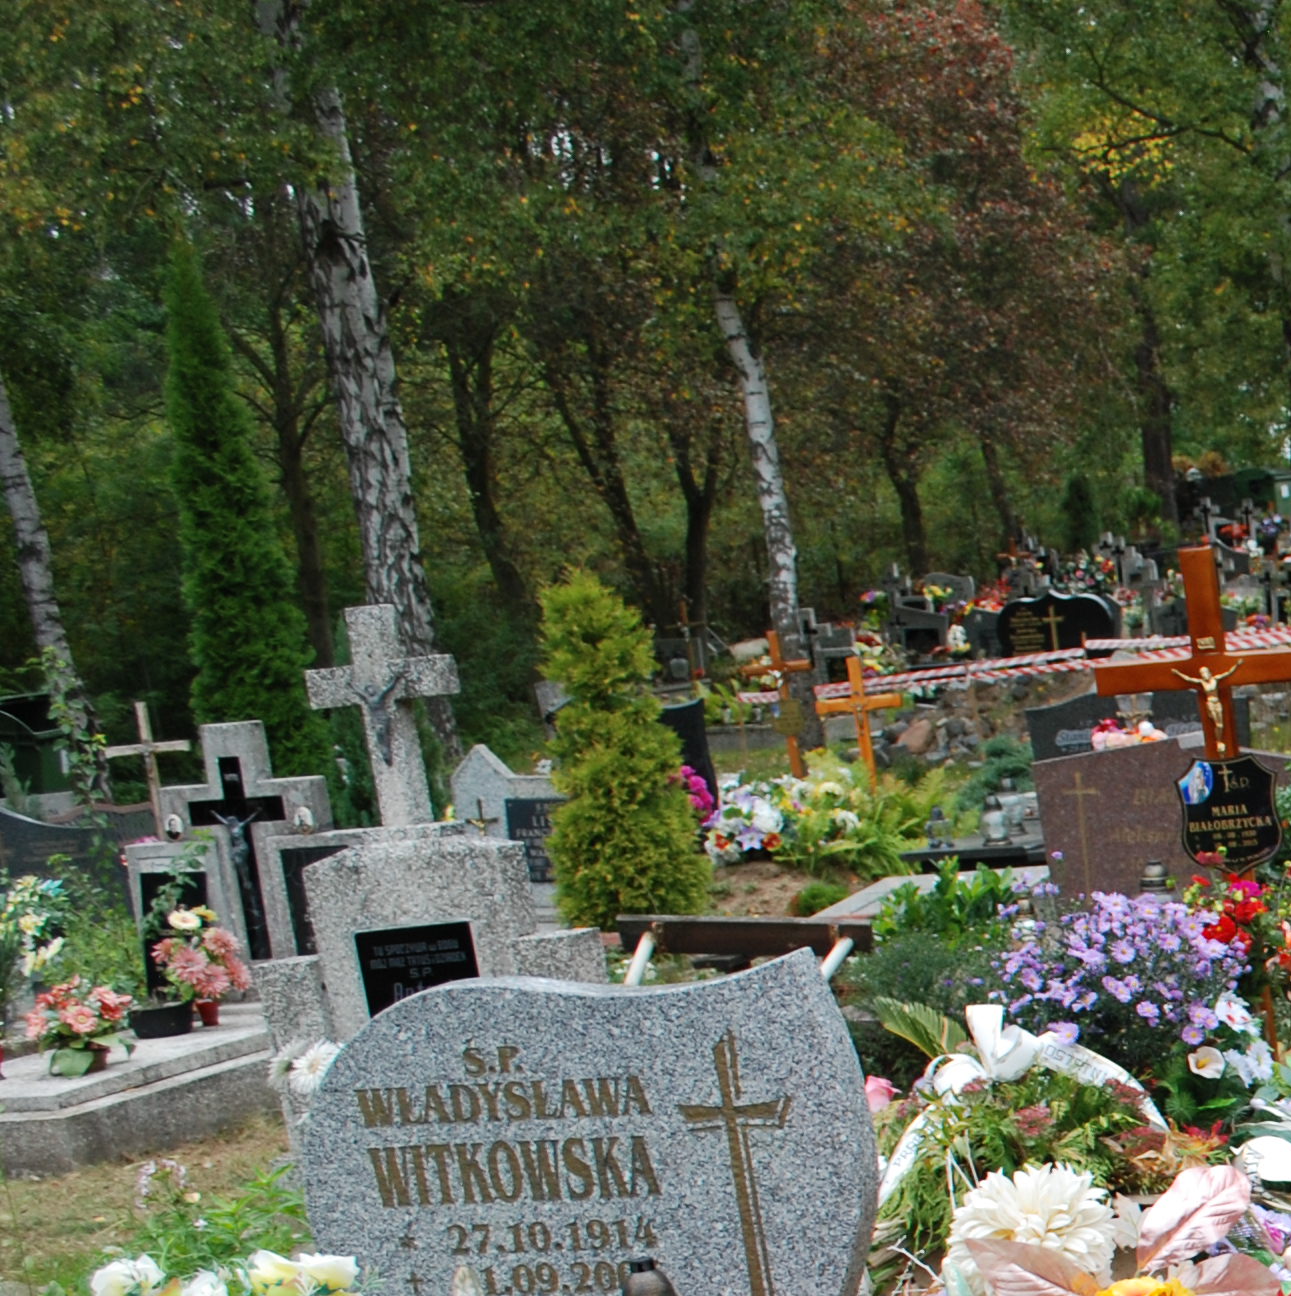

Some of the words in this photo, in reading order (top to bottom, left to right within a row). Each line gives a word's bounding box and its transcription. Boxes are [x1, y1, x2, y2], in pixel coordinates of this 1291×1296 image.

[1188, 815, 1273, 833] BIAŁOBRZYCKA
[1211, 803, 1248, 817] MARIA
[353, 1075, 654, 1129] WŁADYSŁAWA
[367, 1136, 663, 1208] WITKOWSKA
[447, 1217, 659, 1255] 27.10.1914
